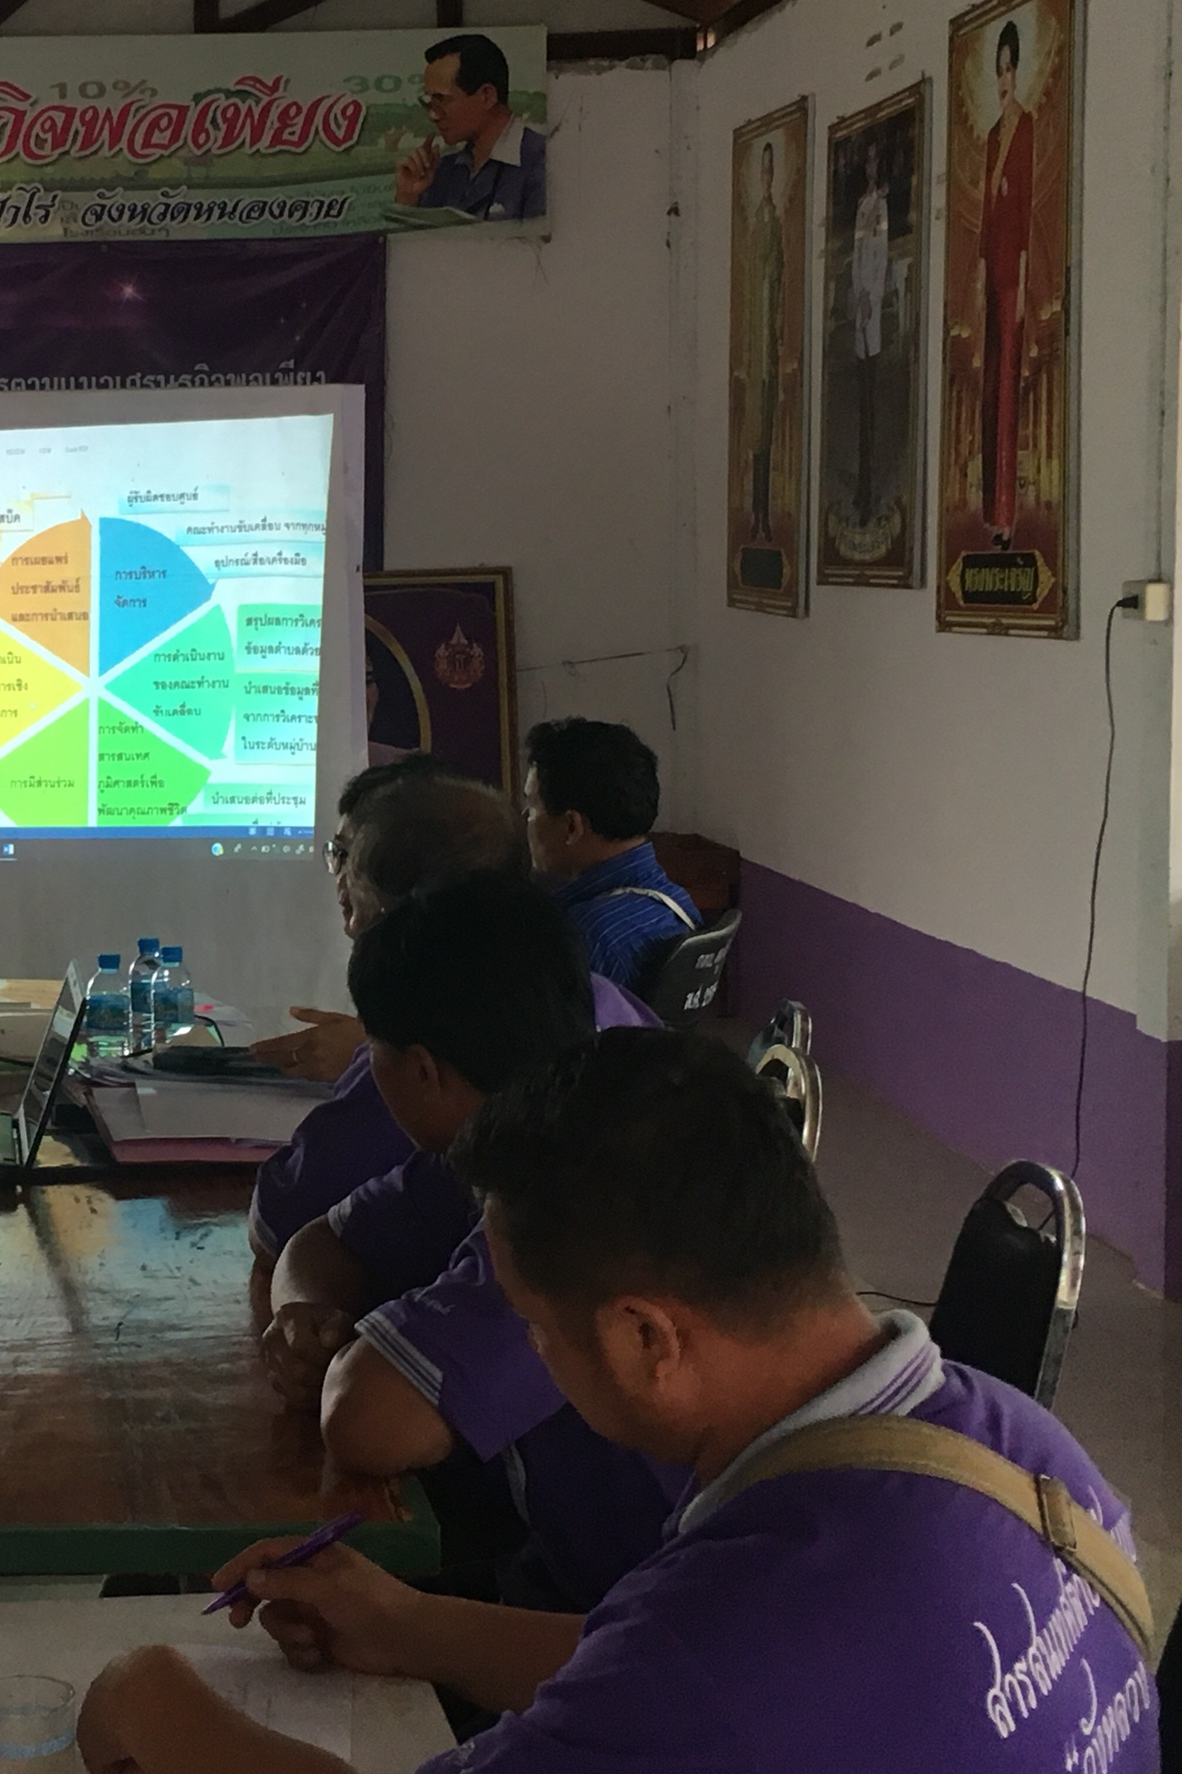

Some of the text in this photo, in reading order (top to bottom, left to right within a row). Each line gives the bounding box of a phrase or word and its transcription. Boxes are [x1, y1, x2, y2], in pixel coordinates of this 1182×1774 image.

[50, 78, 159, 100] 10%
[80, 184, 351, 227] จังหวัดหนองคาย
[115, 566, 168, 581] การบริหาร
[153, 647, 226, 663] การดำเนินงาน
[97, 750, 151, 763] สารสนเทศ
